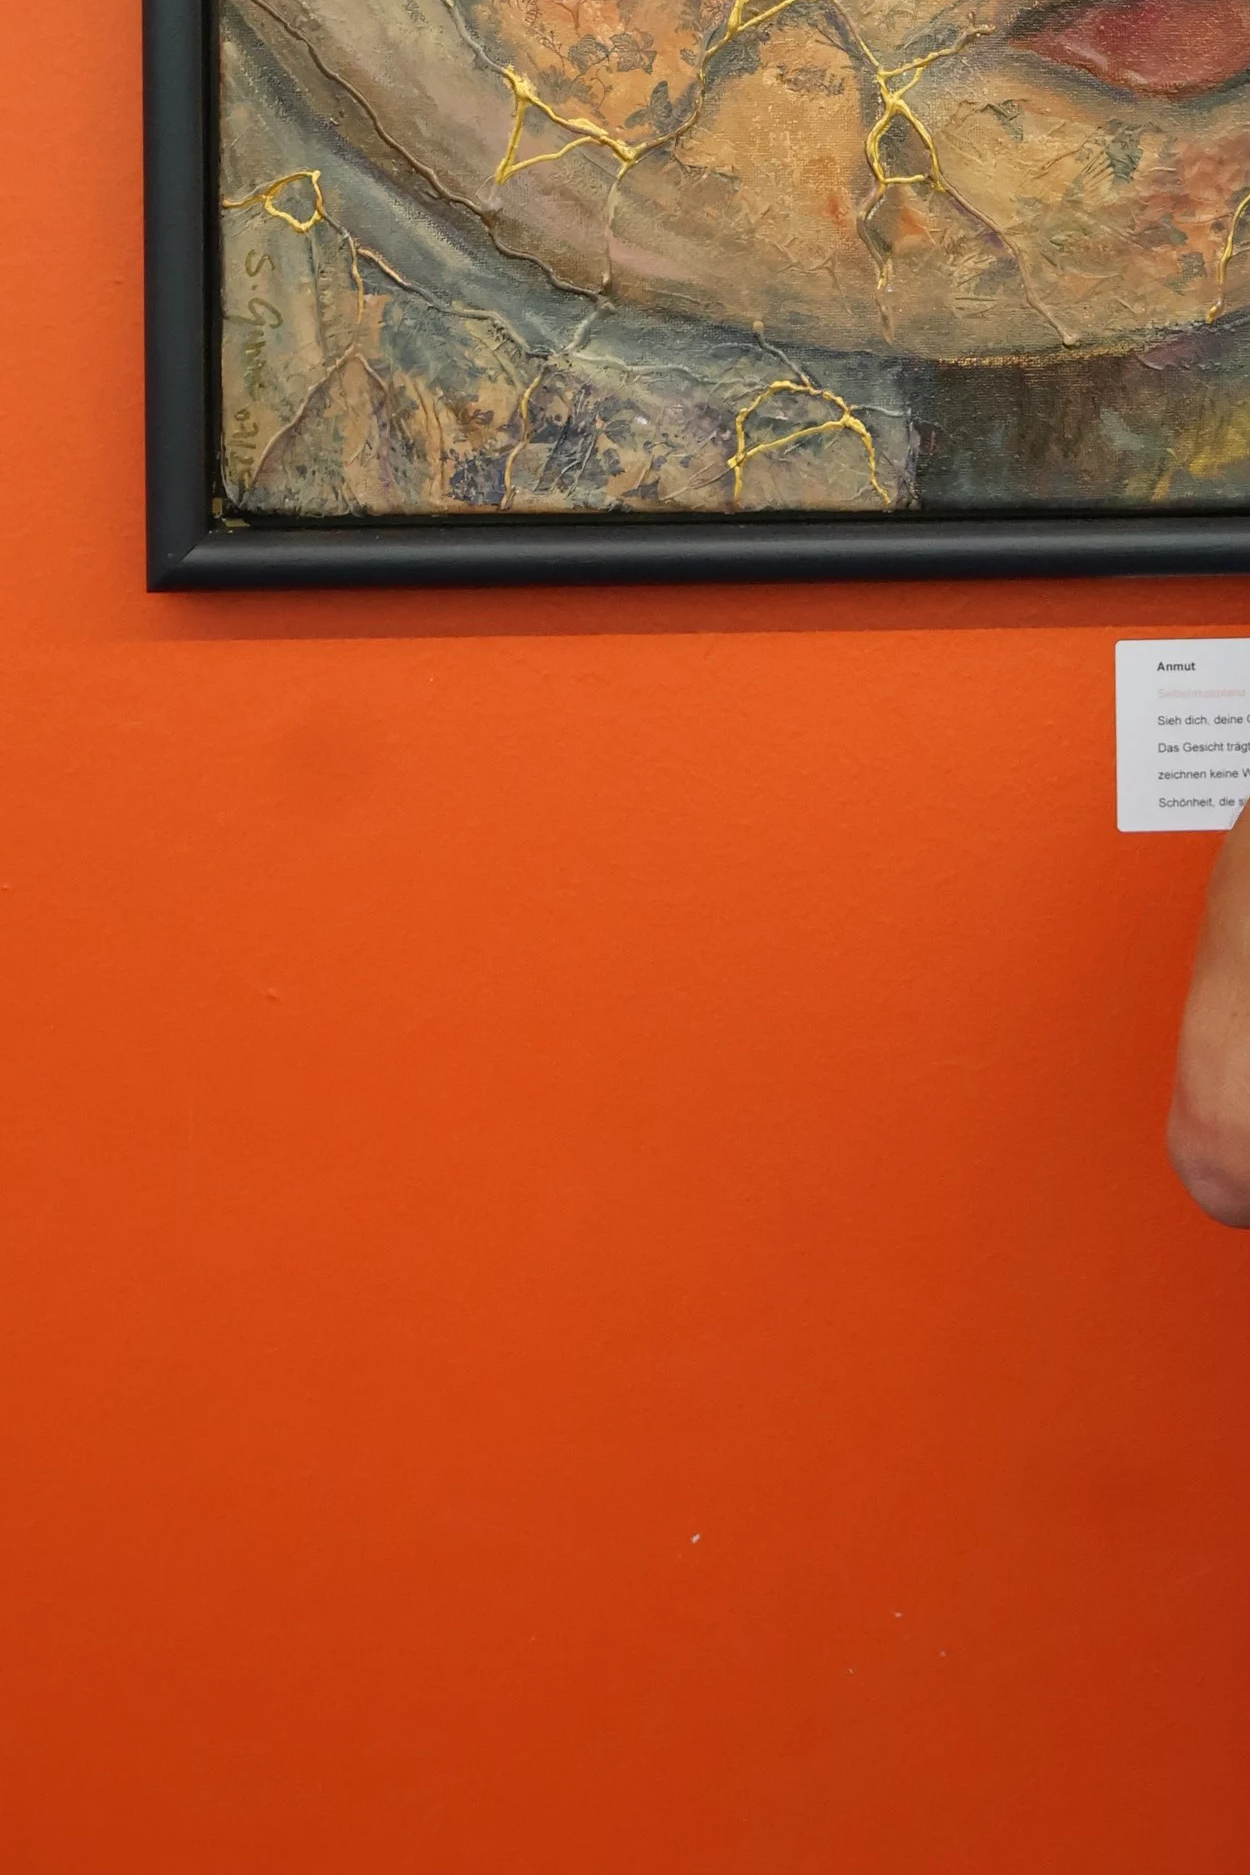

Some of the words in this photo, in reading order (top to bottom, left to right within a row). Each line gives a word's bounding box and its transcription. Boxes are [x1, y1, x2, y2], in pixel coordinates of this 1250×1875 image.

[1157, 661, 1196, 672] Anmut
[1157, 716, 1182, 726] Sieh
[1214, 715, 1243, 725] deine
[1158, 743, 1180, 753] Das
[1182, 742, 1224, 753] Gesicht
[1158, 770, 1207, 780] zeichnen
[1209, 769, 1239, 779] keine
[1158, 797, 1215, 808] Schönheit,
[1219, 796, 1235, 807] die
